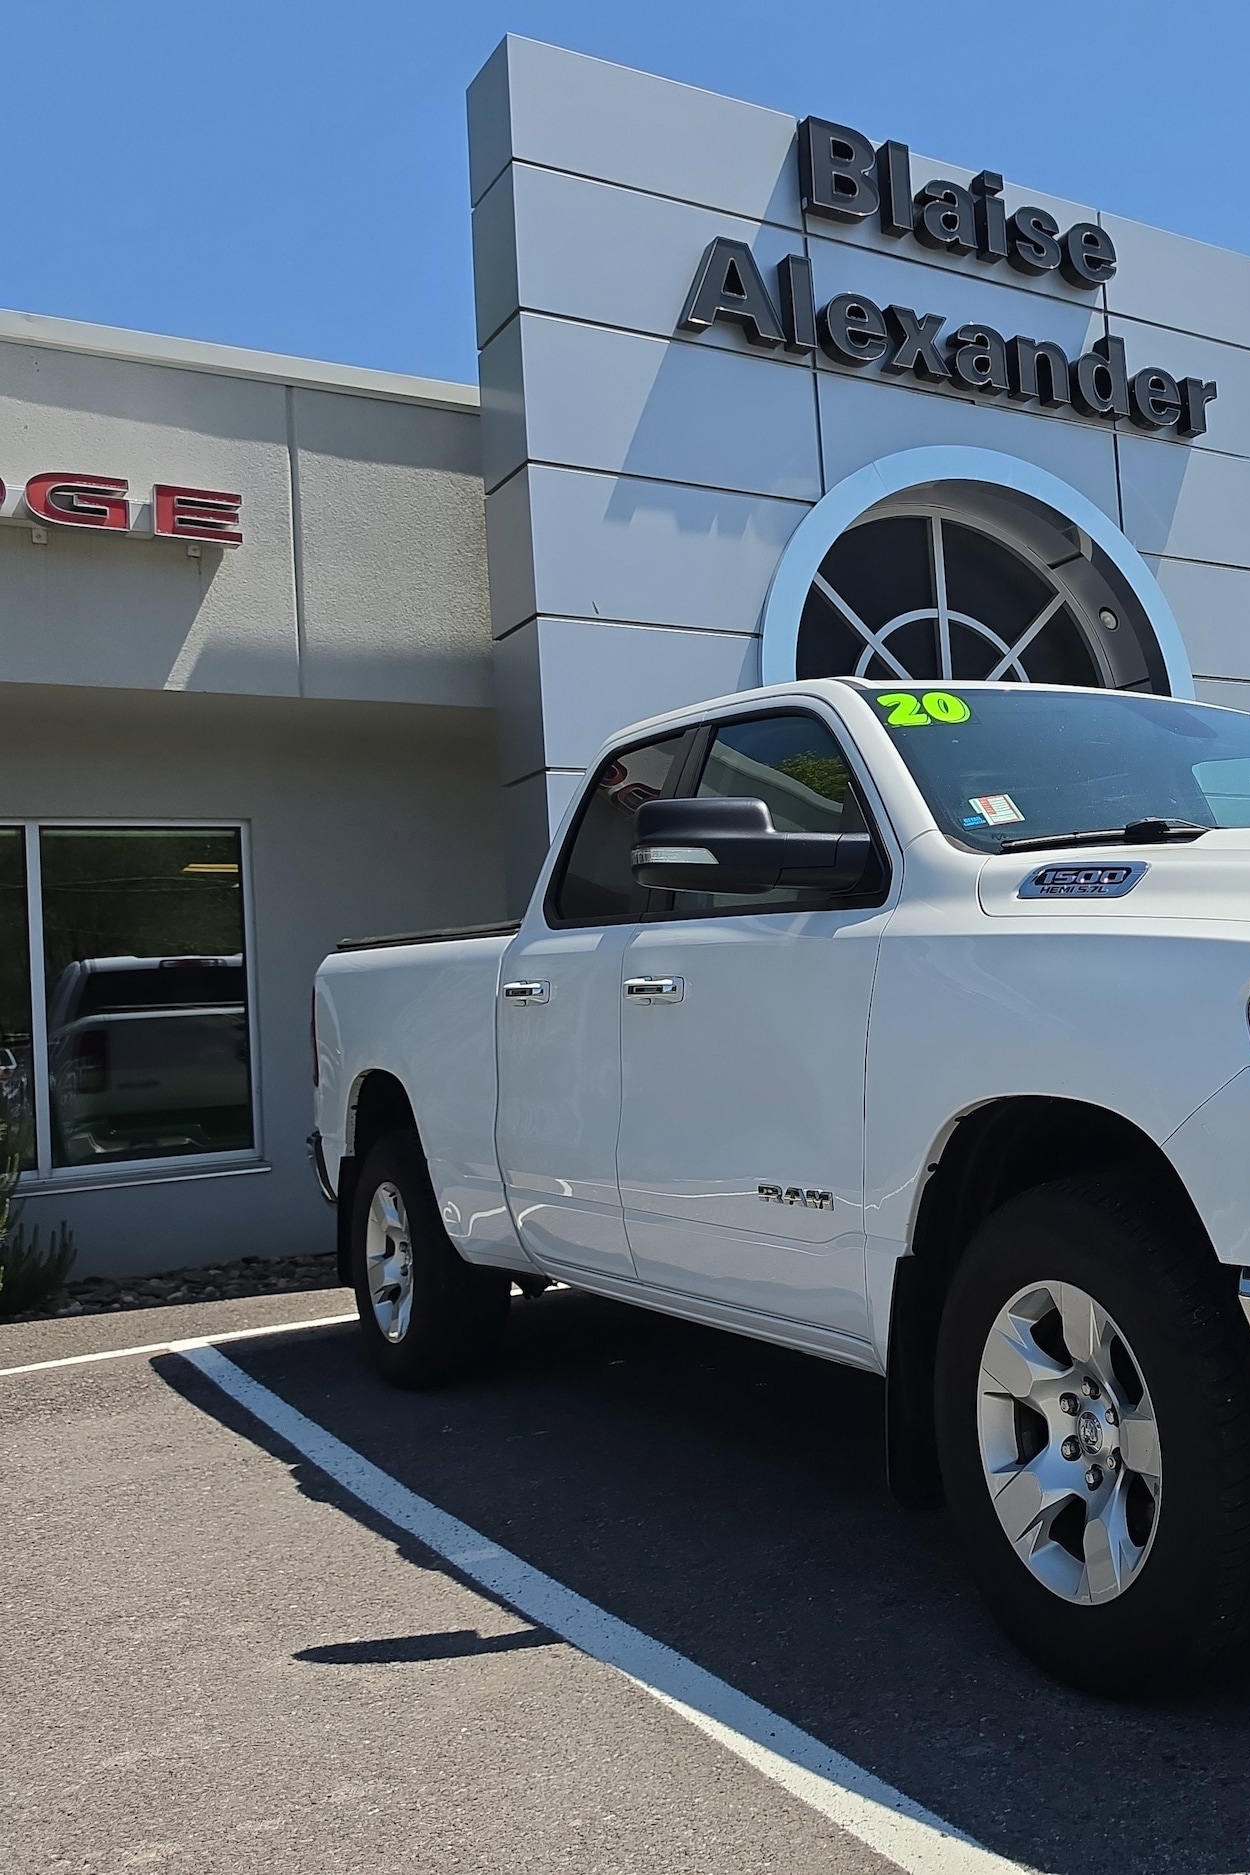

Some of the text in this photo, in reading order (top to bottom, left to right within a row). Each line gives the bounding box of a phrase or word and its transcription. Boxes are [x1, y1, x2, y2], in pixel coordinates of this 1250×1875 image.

[798, 115, 1117, 290] Blaise
[679, 236, 1217, 438] Alexander
[0, 471, 244, 548] GE
[877, 692, 971, 727] 20
[1040, 885, 1109, 894] HEMI 5.7L
[1041, 870, 1128, 884] 1500
[758, 1183, 835, 1211] RAM
